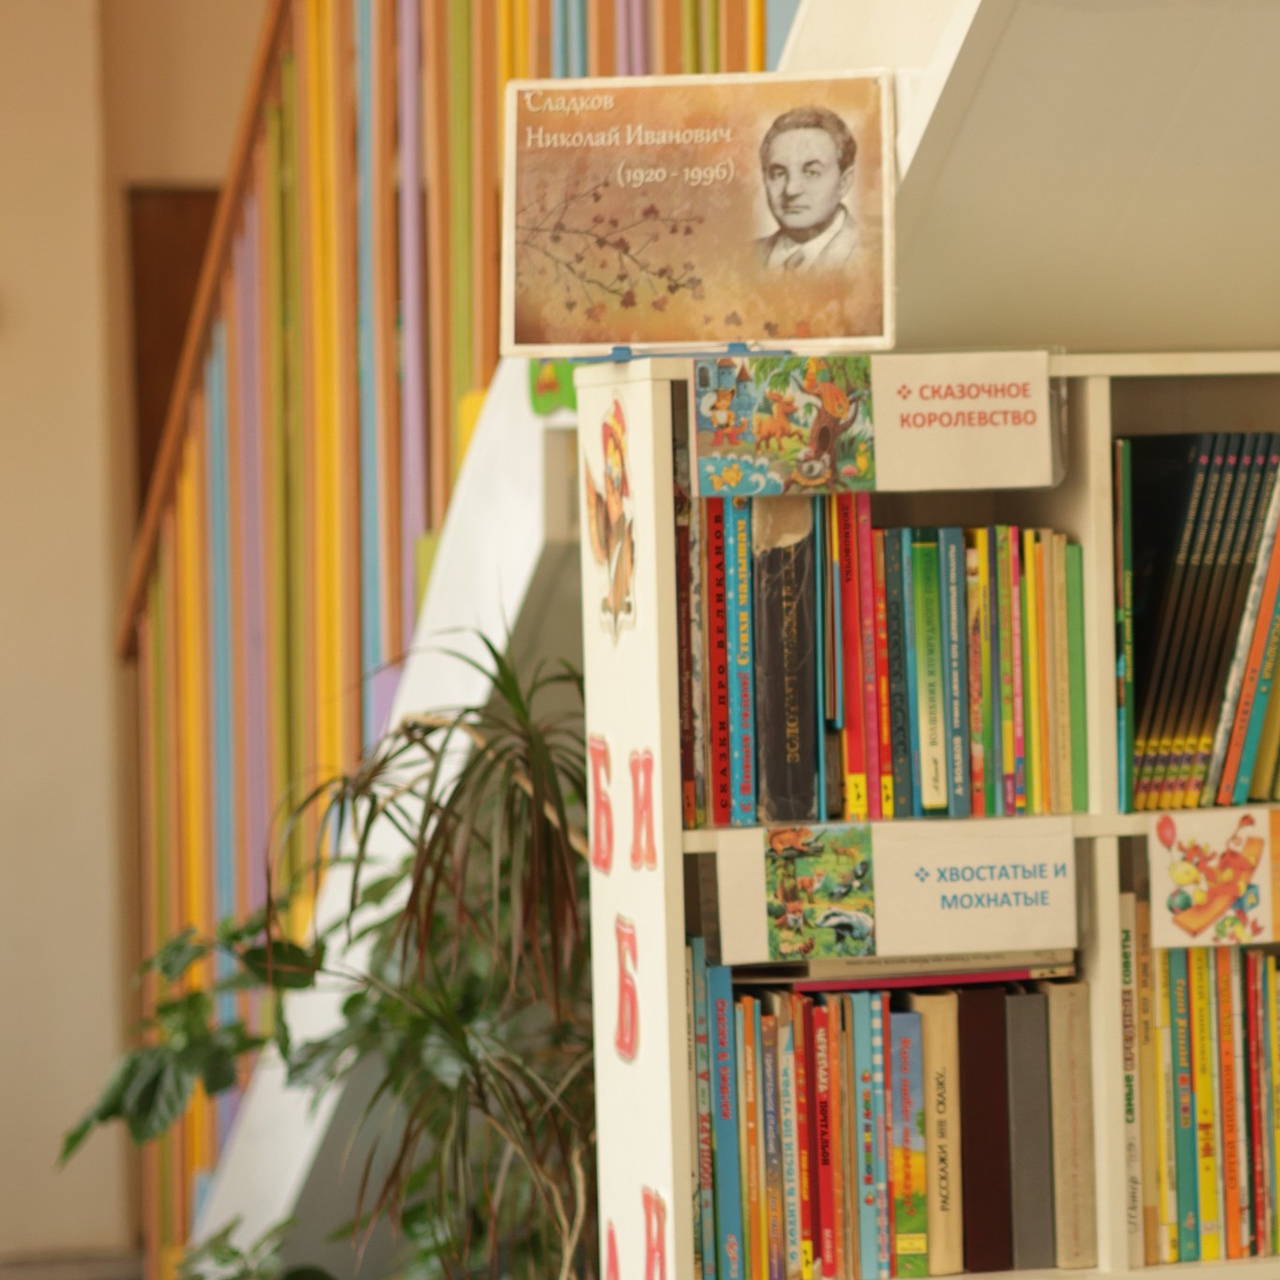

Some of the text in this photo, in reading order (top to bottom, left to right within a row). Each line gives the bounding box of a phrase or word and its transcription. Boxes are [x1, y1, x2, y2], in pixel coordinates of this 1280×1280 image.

[524, 90, 616, 115] Сладков
[525, 124, 734, 149] Николай Иванович
[616, 161, 667, 187] (1920
[682, 160, 737, 185] 1996)
[919, 382, 1032, 402] СКАЗОЧНОЕ
[900, 408, 1038, 429] КОРОЛЕВСТВО
[842, 505, 852, 583] ДЮЙМОВОЧКА
[714, 513, 727, 808] СКАЗКИ ПРО ВЕЛИКАНОВ
[736, 610, 749, 666] Стихи
[921, 551, 938, 747] ВОЛШЕБНИК ИЗУМРУДНОГО ГОРОДА
[936, 862, 1067, 882] ХВОСТАТЫЕ И
[940, 891, 1050, 910] МОХНАТЫЕ
[1120, 929, 1132, 985] советы
[717, 998, 728, 1048] СКАЗКИ
[1122, 989, 1135, 1071] ВРЕДНЫЕ
[697, 1069, 709, 1081] А
[719, 1067, 731, 1120] БИАНКИ
[1123, 1075, 1135, 1124] самые
[1224, 1064, 1236, 1134] МИХАЛКОВ
[698, 1111, 713, 1191] ЗООПАРК
[784, 1118, 794, 1138] ПО
[819, 1100, 830, 1166] ПОЧТАЛЬОН
[936, 1119, 947, 1139] МНЕ
[785, 1141, 795, 1184] ГОСТИ
[937, 1145, 950, 1212] РАССКАЖИ
[1227, 1141, 1237, 1190] СЕРГЕЙ
[786, 1202, 796, 1247] ХОДИТ
